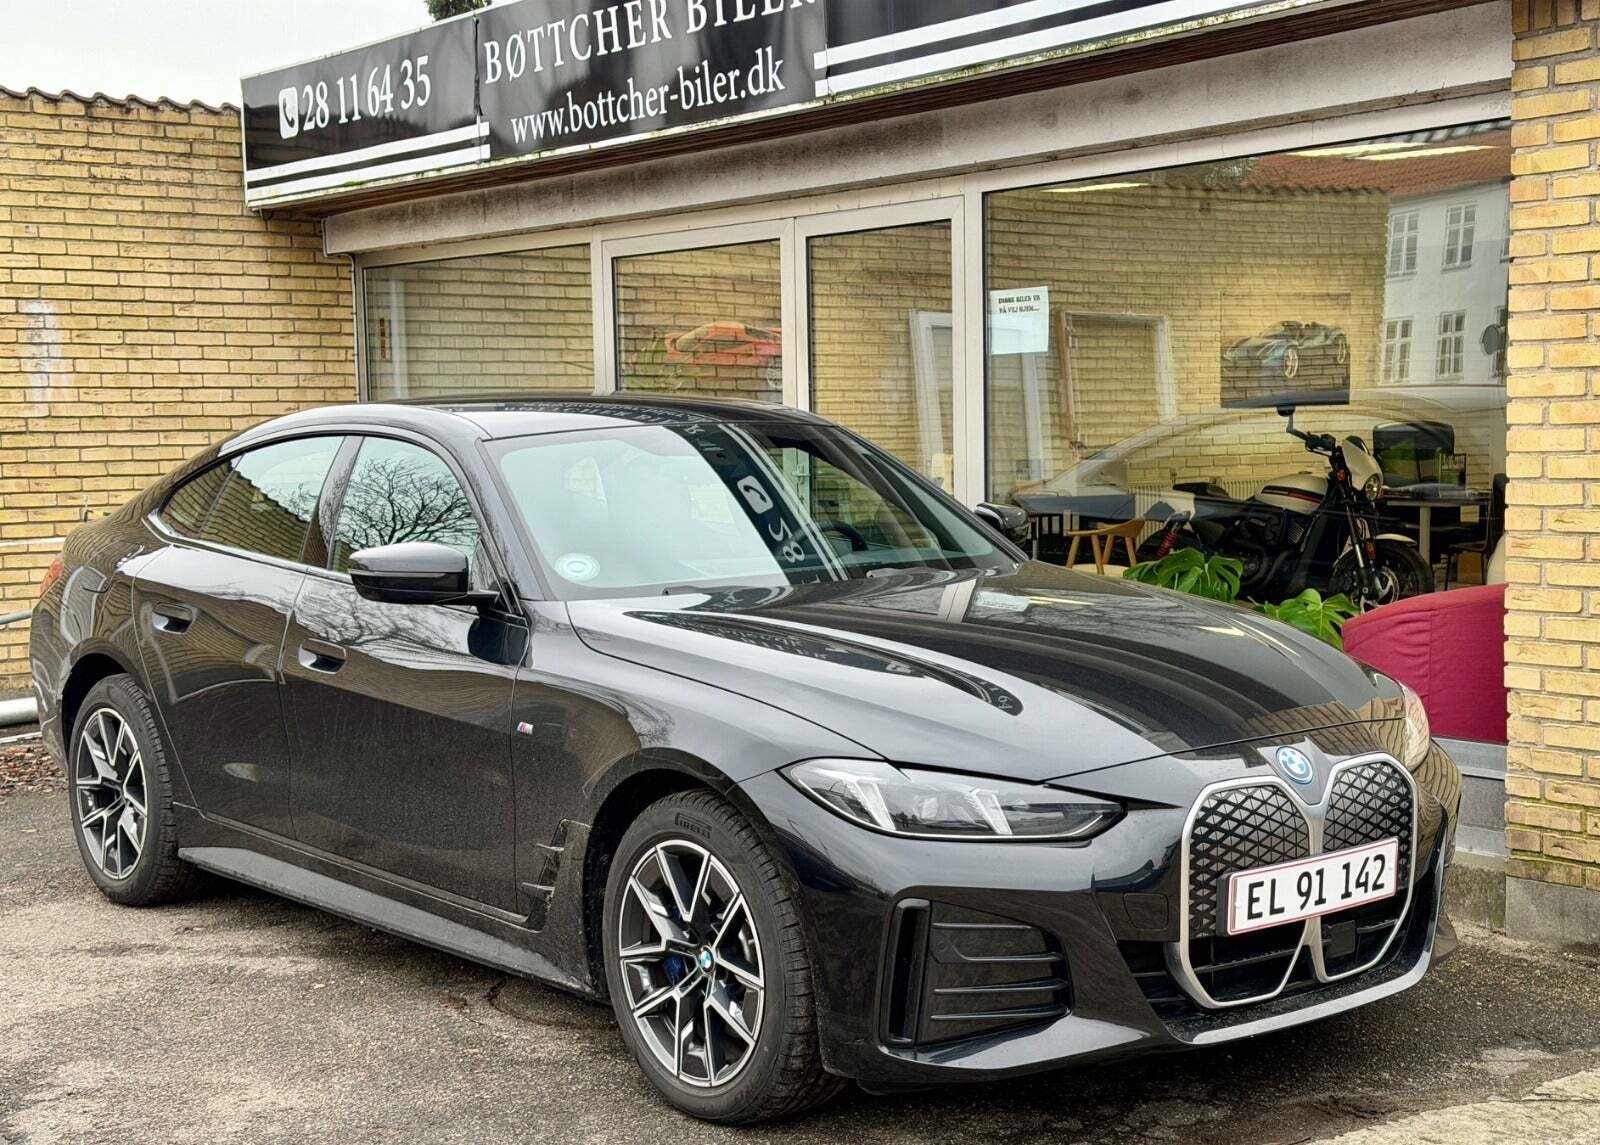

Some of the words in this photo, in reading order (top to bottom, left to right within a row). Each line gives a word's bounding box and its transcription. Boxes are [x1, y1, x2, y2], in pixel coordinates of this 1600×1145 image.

[484, 0, 673, 84] BØTTCHER
[302, 81, 330, 131] 28
[336, 73, 361, 124] 11
[367, 64, 394, 117] 64
[399, 55, 431, 110] 35
[510, 45, 785, 145] www.bottcher-biler.dk
[674, 812, 713, 839] PIRELLI
[1247, 878, 1285, 921] EL
[1297, 867, 1327, 912] 91
[1340, 853, 1386, 900] 142
